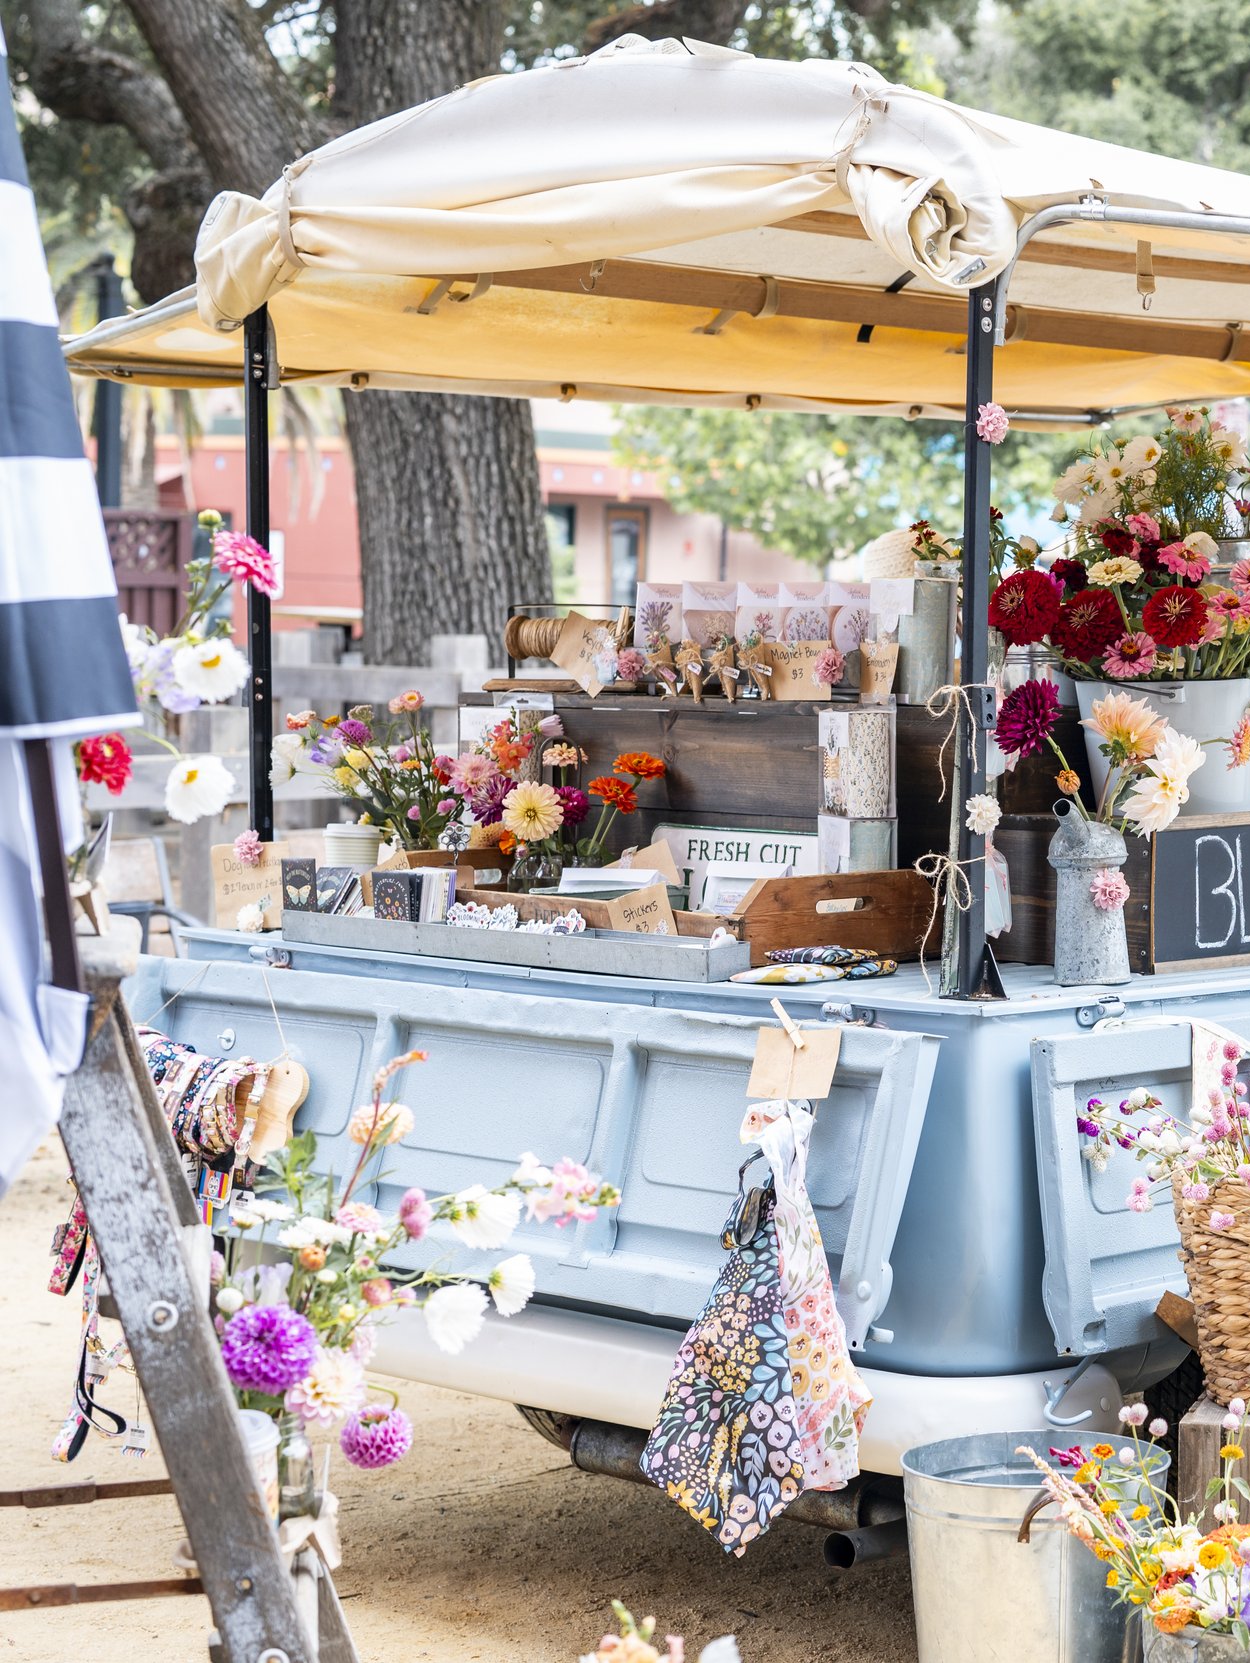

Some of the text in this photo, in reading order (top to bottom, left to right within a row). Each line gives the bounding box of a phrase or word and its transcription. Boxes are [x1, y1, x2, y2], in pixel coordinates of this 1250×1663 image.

[770, 648, 803, 665] Magnet
[791, 668, 804, 680] $3
[687, 839, 802, 867] FRESH CUT
[222, 858, 243, 875] Dog
[623, 901, 658, 923] Stickers
